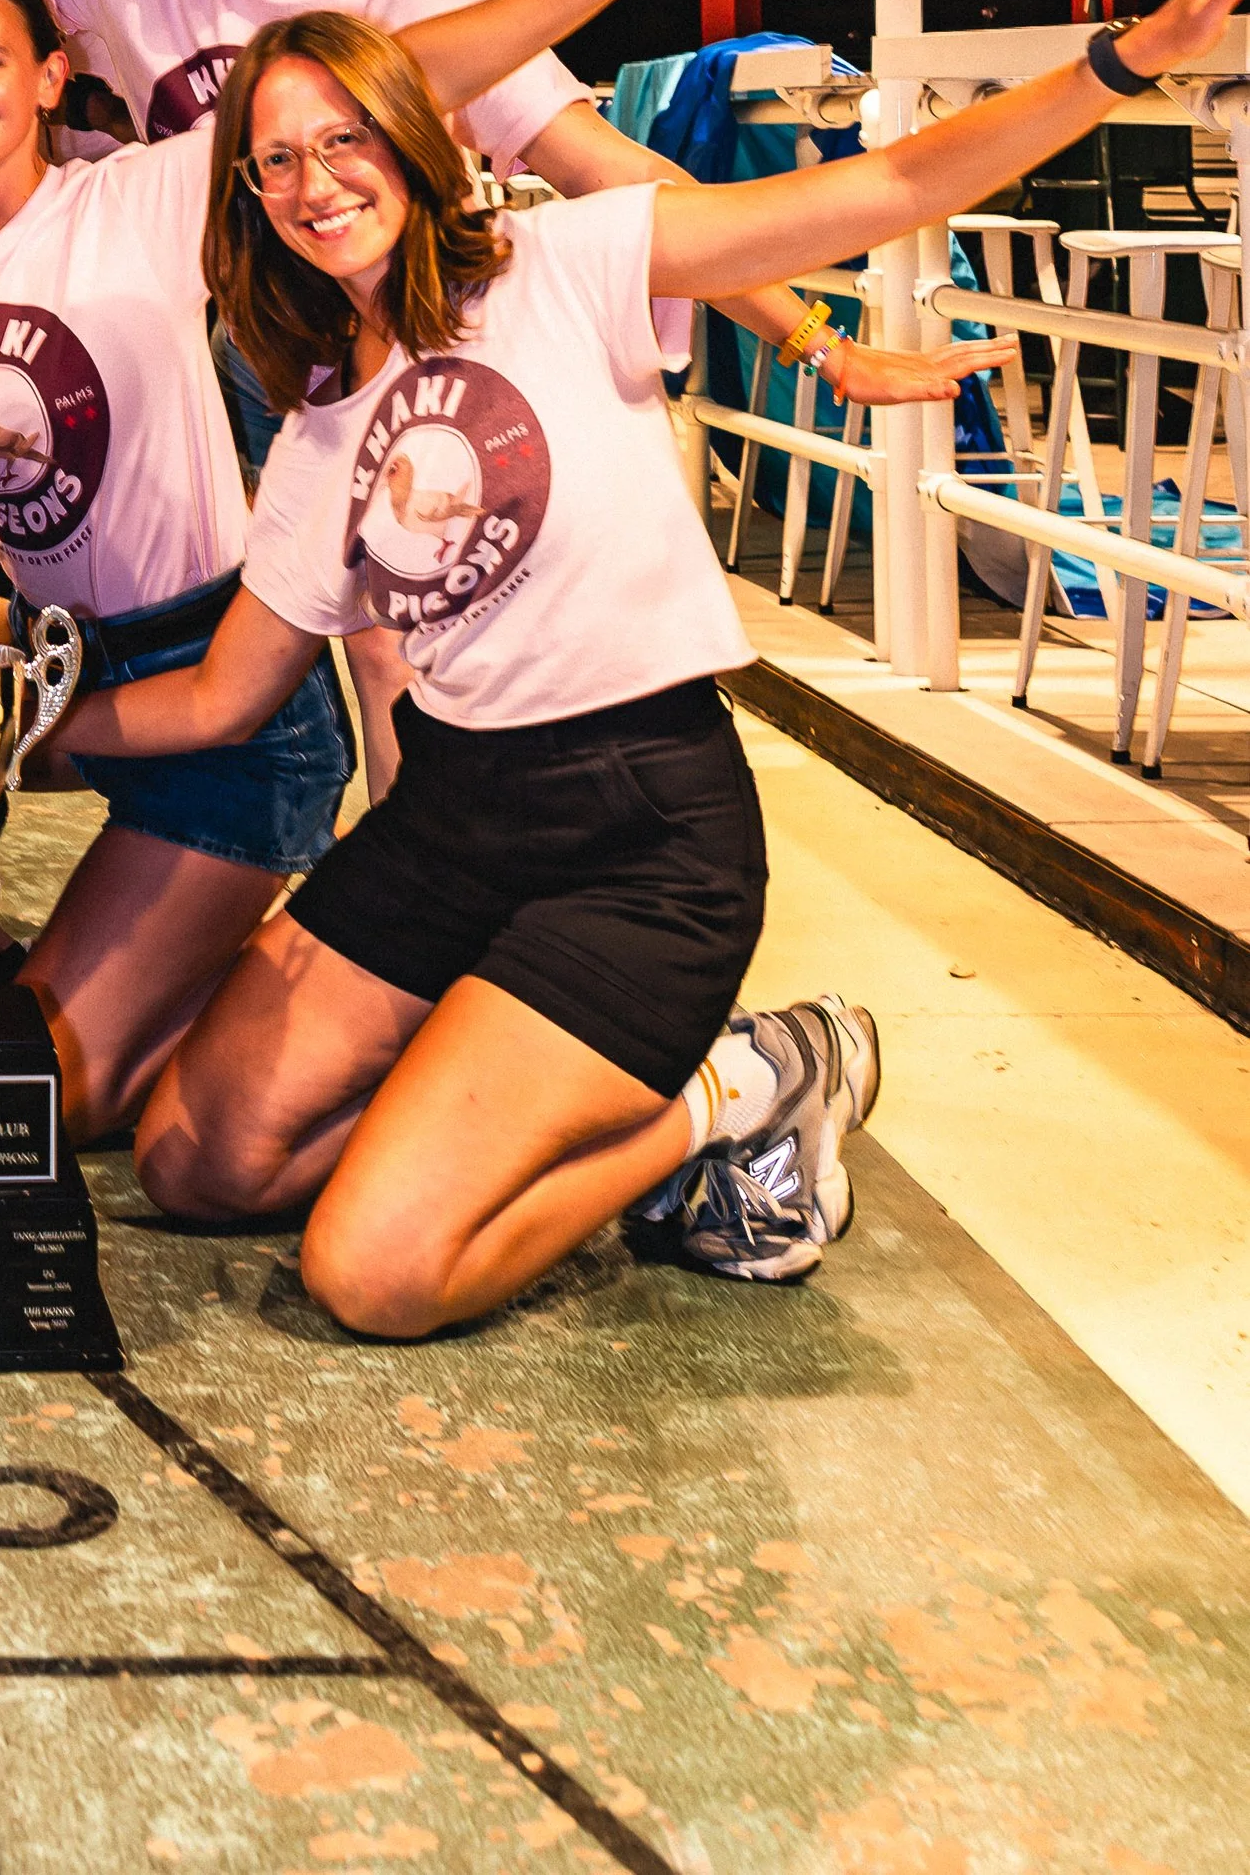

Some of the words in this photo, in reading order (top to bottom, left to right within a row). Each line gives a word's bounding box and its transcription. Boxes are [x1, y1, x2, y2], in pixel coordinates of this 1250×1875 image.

[54, 386, 94, 411] PALMS
[350, 374, 467, 501] KHAKI
[484, 422, 529, 453] PALMS
[28, 556, 42, 567] ON
[42, 553, 64, 567] THE
